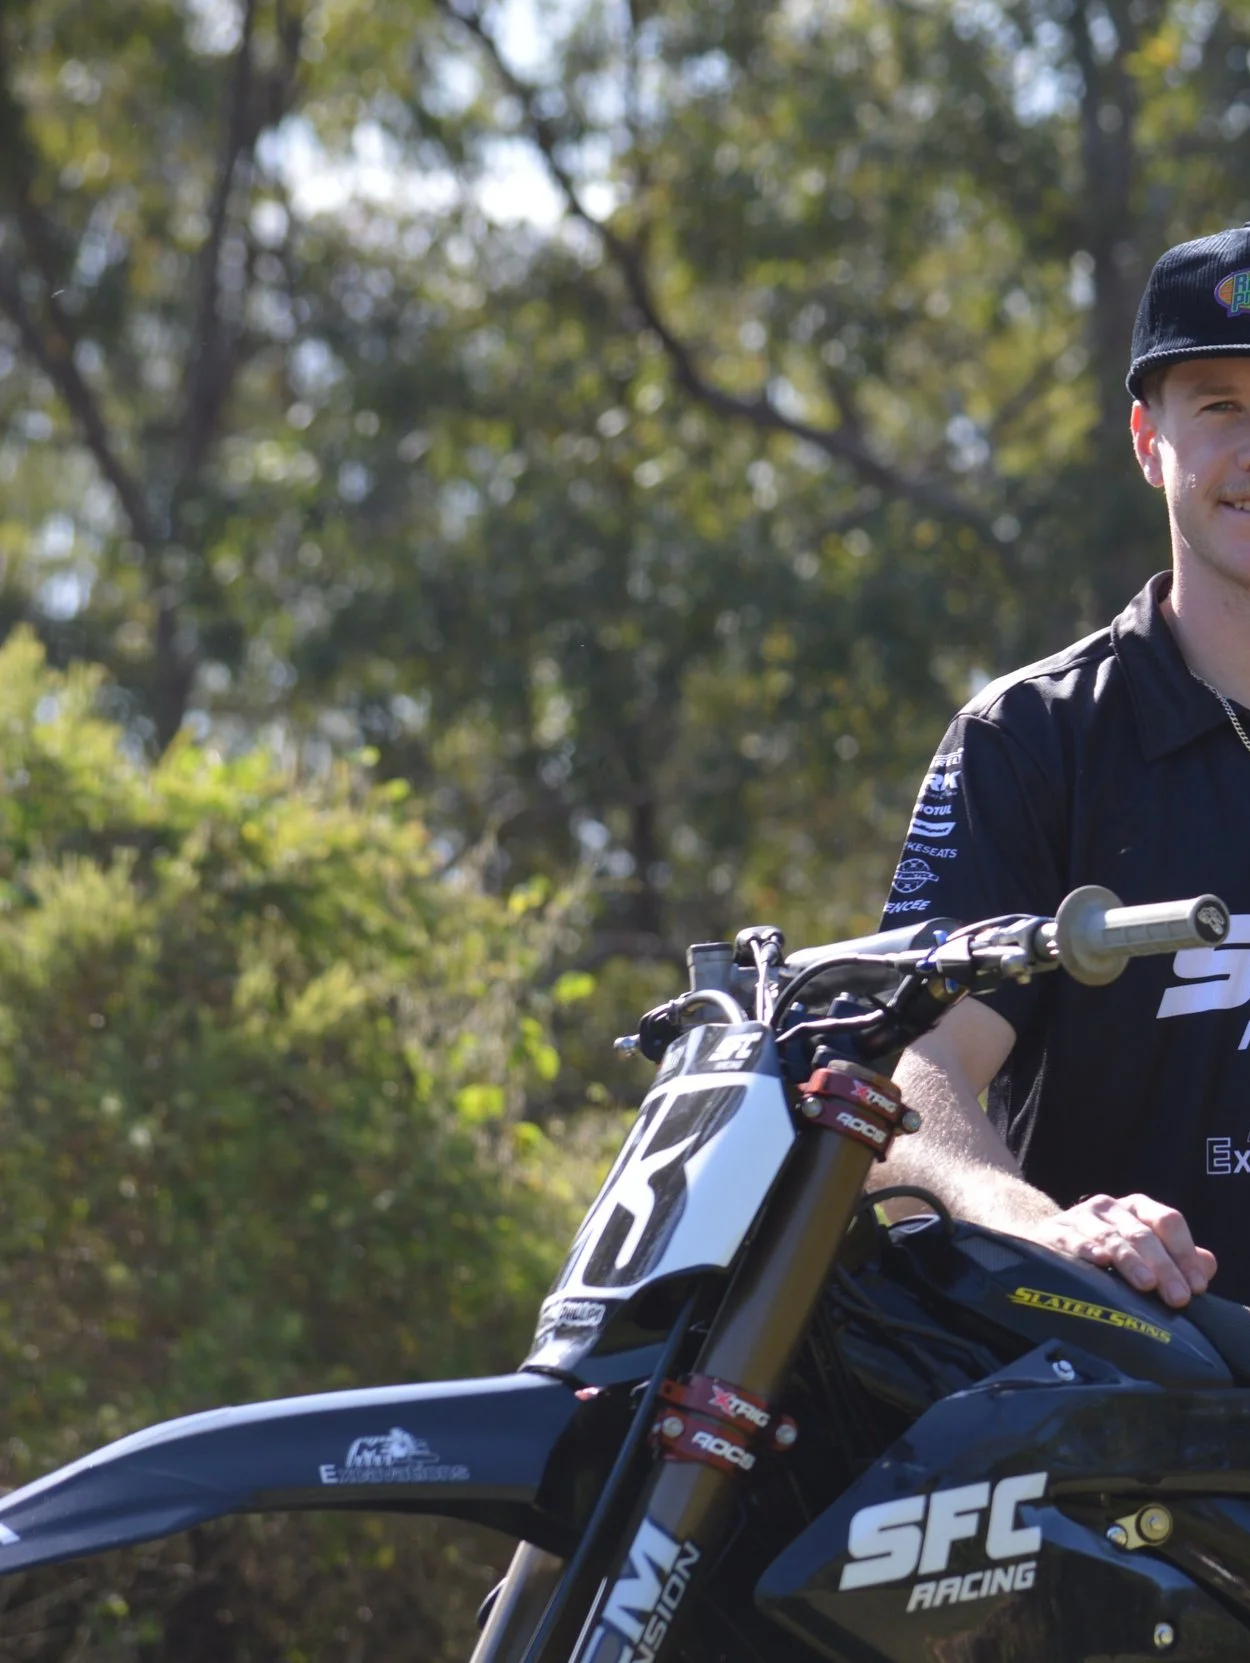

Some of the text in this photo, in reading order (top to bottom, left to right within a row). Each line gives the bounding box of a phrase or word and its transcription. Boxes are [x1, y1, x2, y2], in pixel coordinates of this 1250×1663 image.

[1014, 1286, 1103, 1320] SLATER
[839, 1471, 1048, 1591] SFC
[906, 1561, 1037, 1613] RACING
